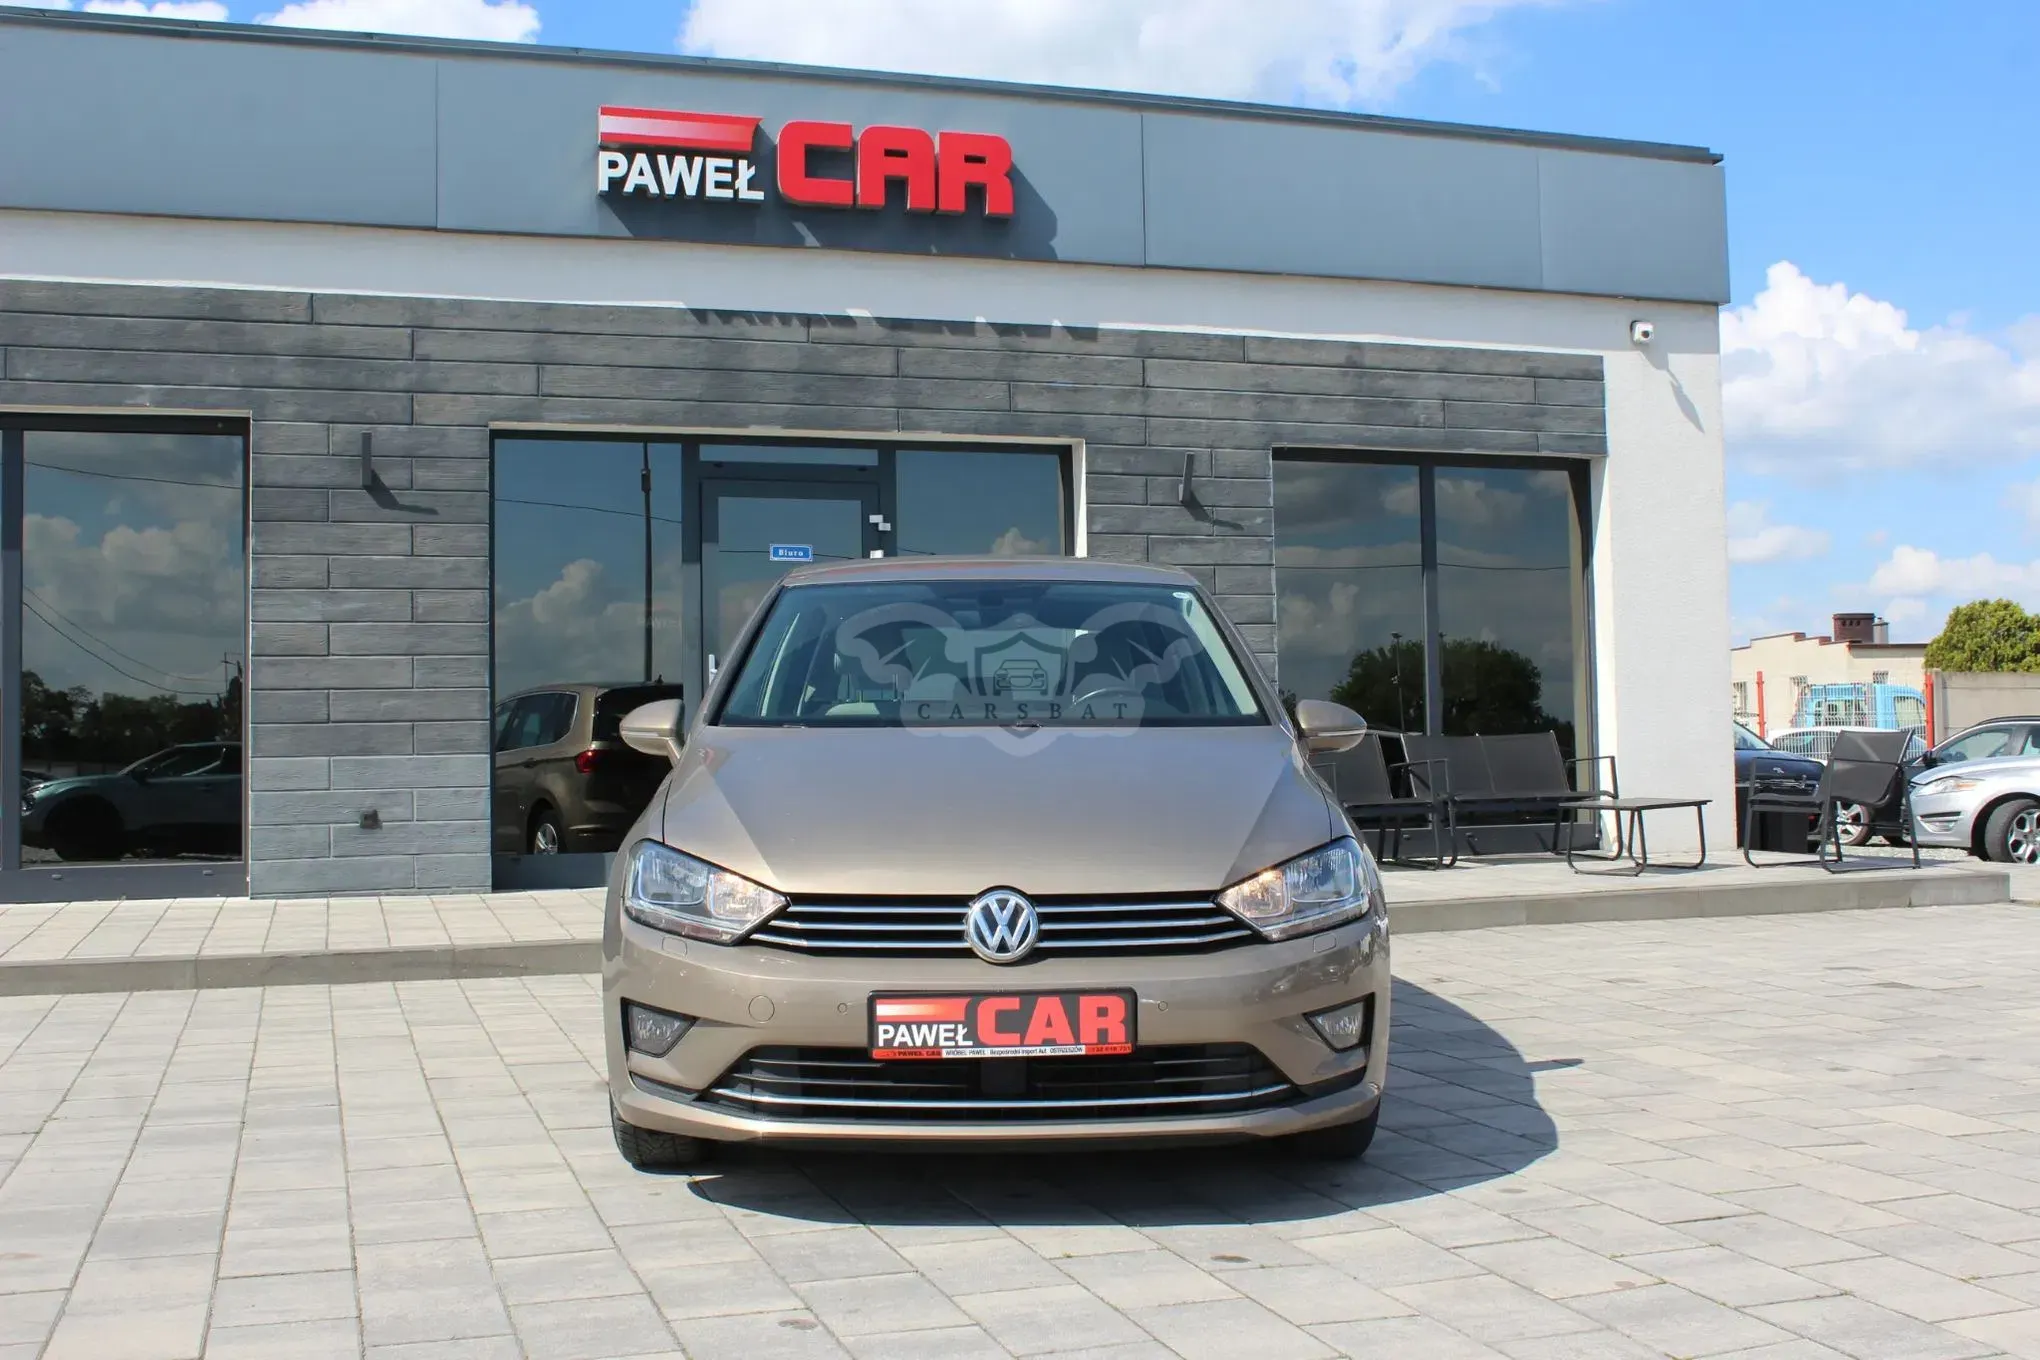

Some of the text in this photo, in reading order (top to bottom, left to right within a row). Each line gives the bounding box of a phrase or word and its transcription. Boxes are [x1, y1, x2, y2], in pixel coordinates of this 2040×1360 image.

[598, 120, 1015, 218] PAWEŁ CAR
[778, 548, 804, 557] Biuro
[878, 995, 1127, 1047] PAWEŁ CAR
